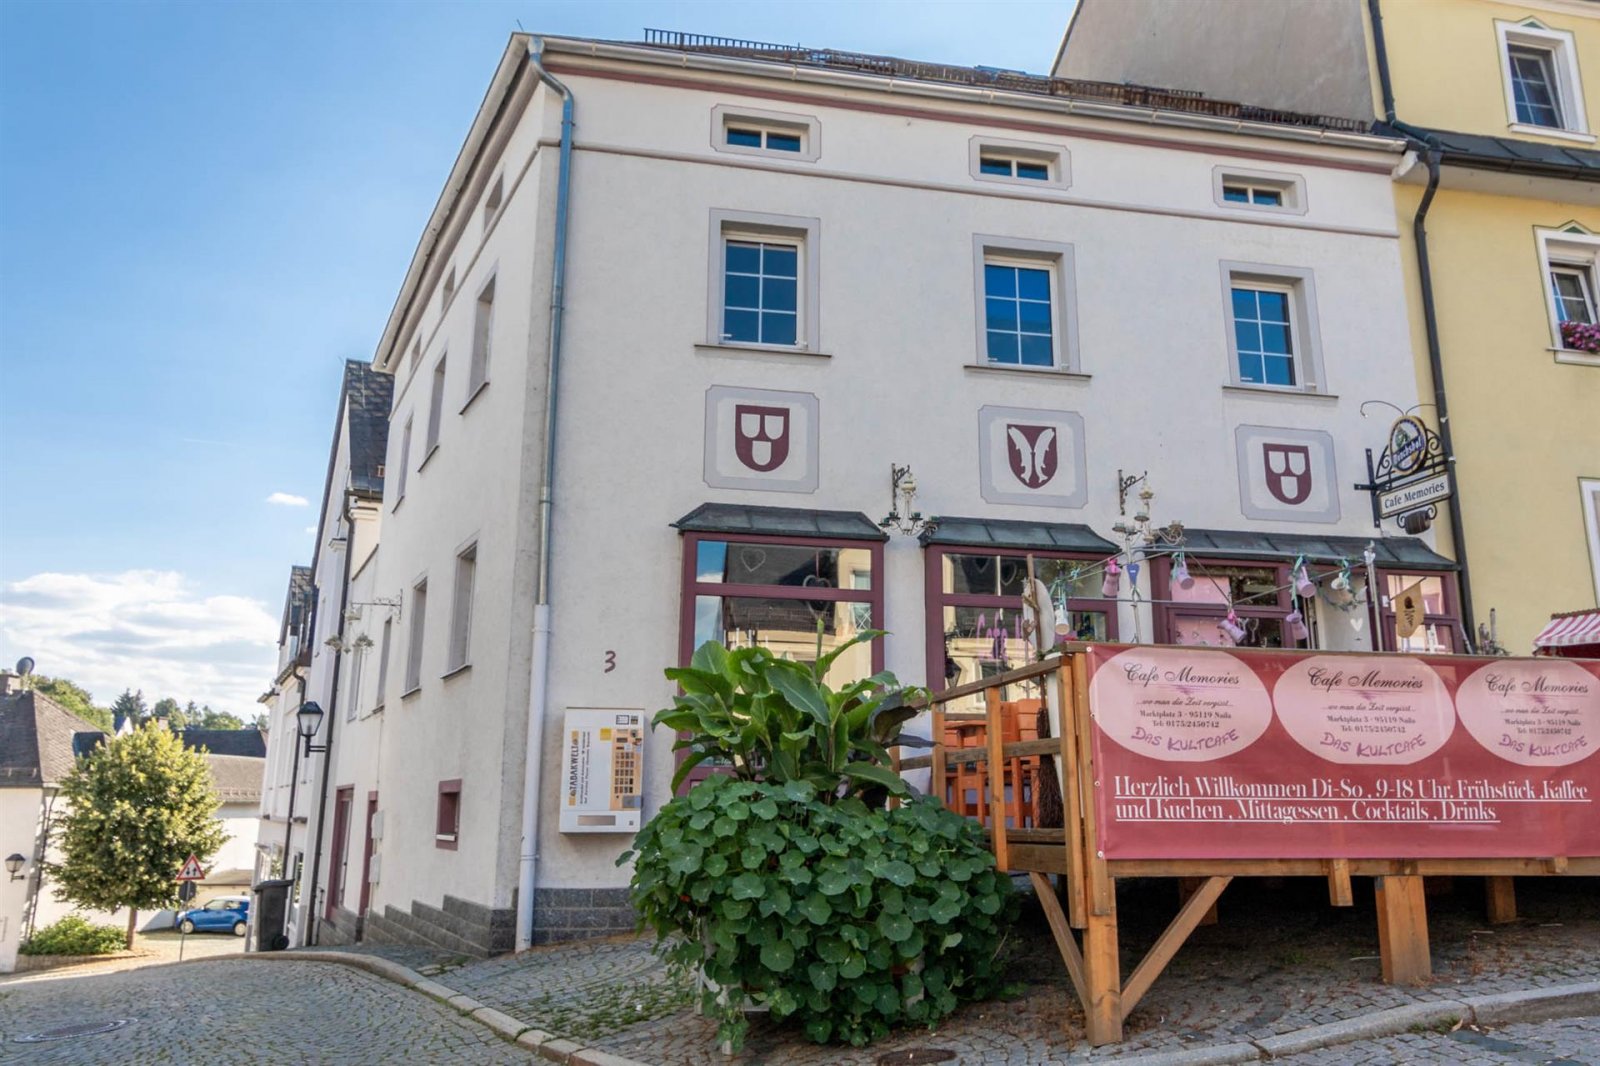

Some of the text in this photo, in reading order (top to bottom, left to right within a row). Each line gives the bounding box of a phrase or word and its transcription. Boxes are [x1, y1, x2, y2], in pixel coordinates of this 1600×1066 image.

[1384, 482, 1445, 509] Cafe Memories
[604, 650, 616, 673] 3
[1124, 663, 1240, 687] Cafe Memories
[1308, 667, 1423, 692] Cafe Memories
[1485, 674, 1589, 698] Cafe Memories
[1140, 710, 1176, 718] Marktplatz
[1131, 726, 1240, 751] DAS KULTCAFE
[1320, 731, 1427, 757] DAS KULTCAFE
[1498, 733, 1588, 757] DAS KULTCAFE
[1115, 776, 1190, 796] Herzlich
[1195, 776, 1307, 797] Willkommen
[1312, 778, 1363, 798] Di-So
[1376, 779, 1414, 798] 9-18
[1458, 779, 1535, 799] Frühstück
[1116, 799, 1150, 818] und
[1156, 800, 1224, 819] Kuchen
[1238, 800, 1339, 824] Mittagessen
[1352, 800, 1429, 820] Cocktails
[1442, 800, 1496, 820] Drinks
